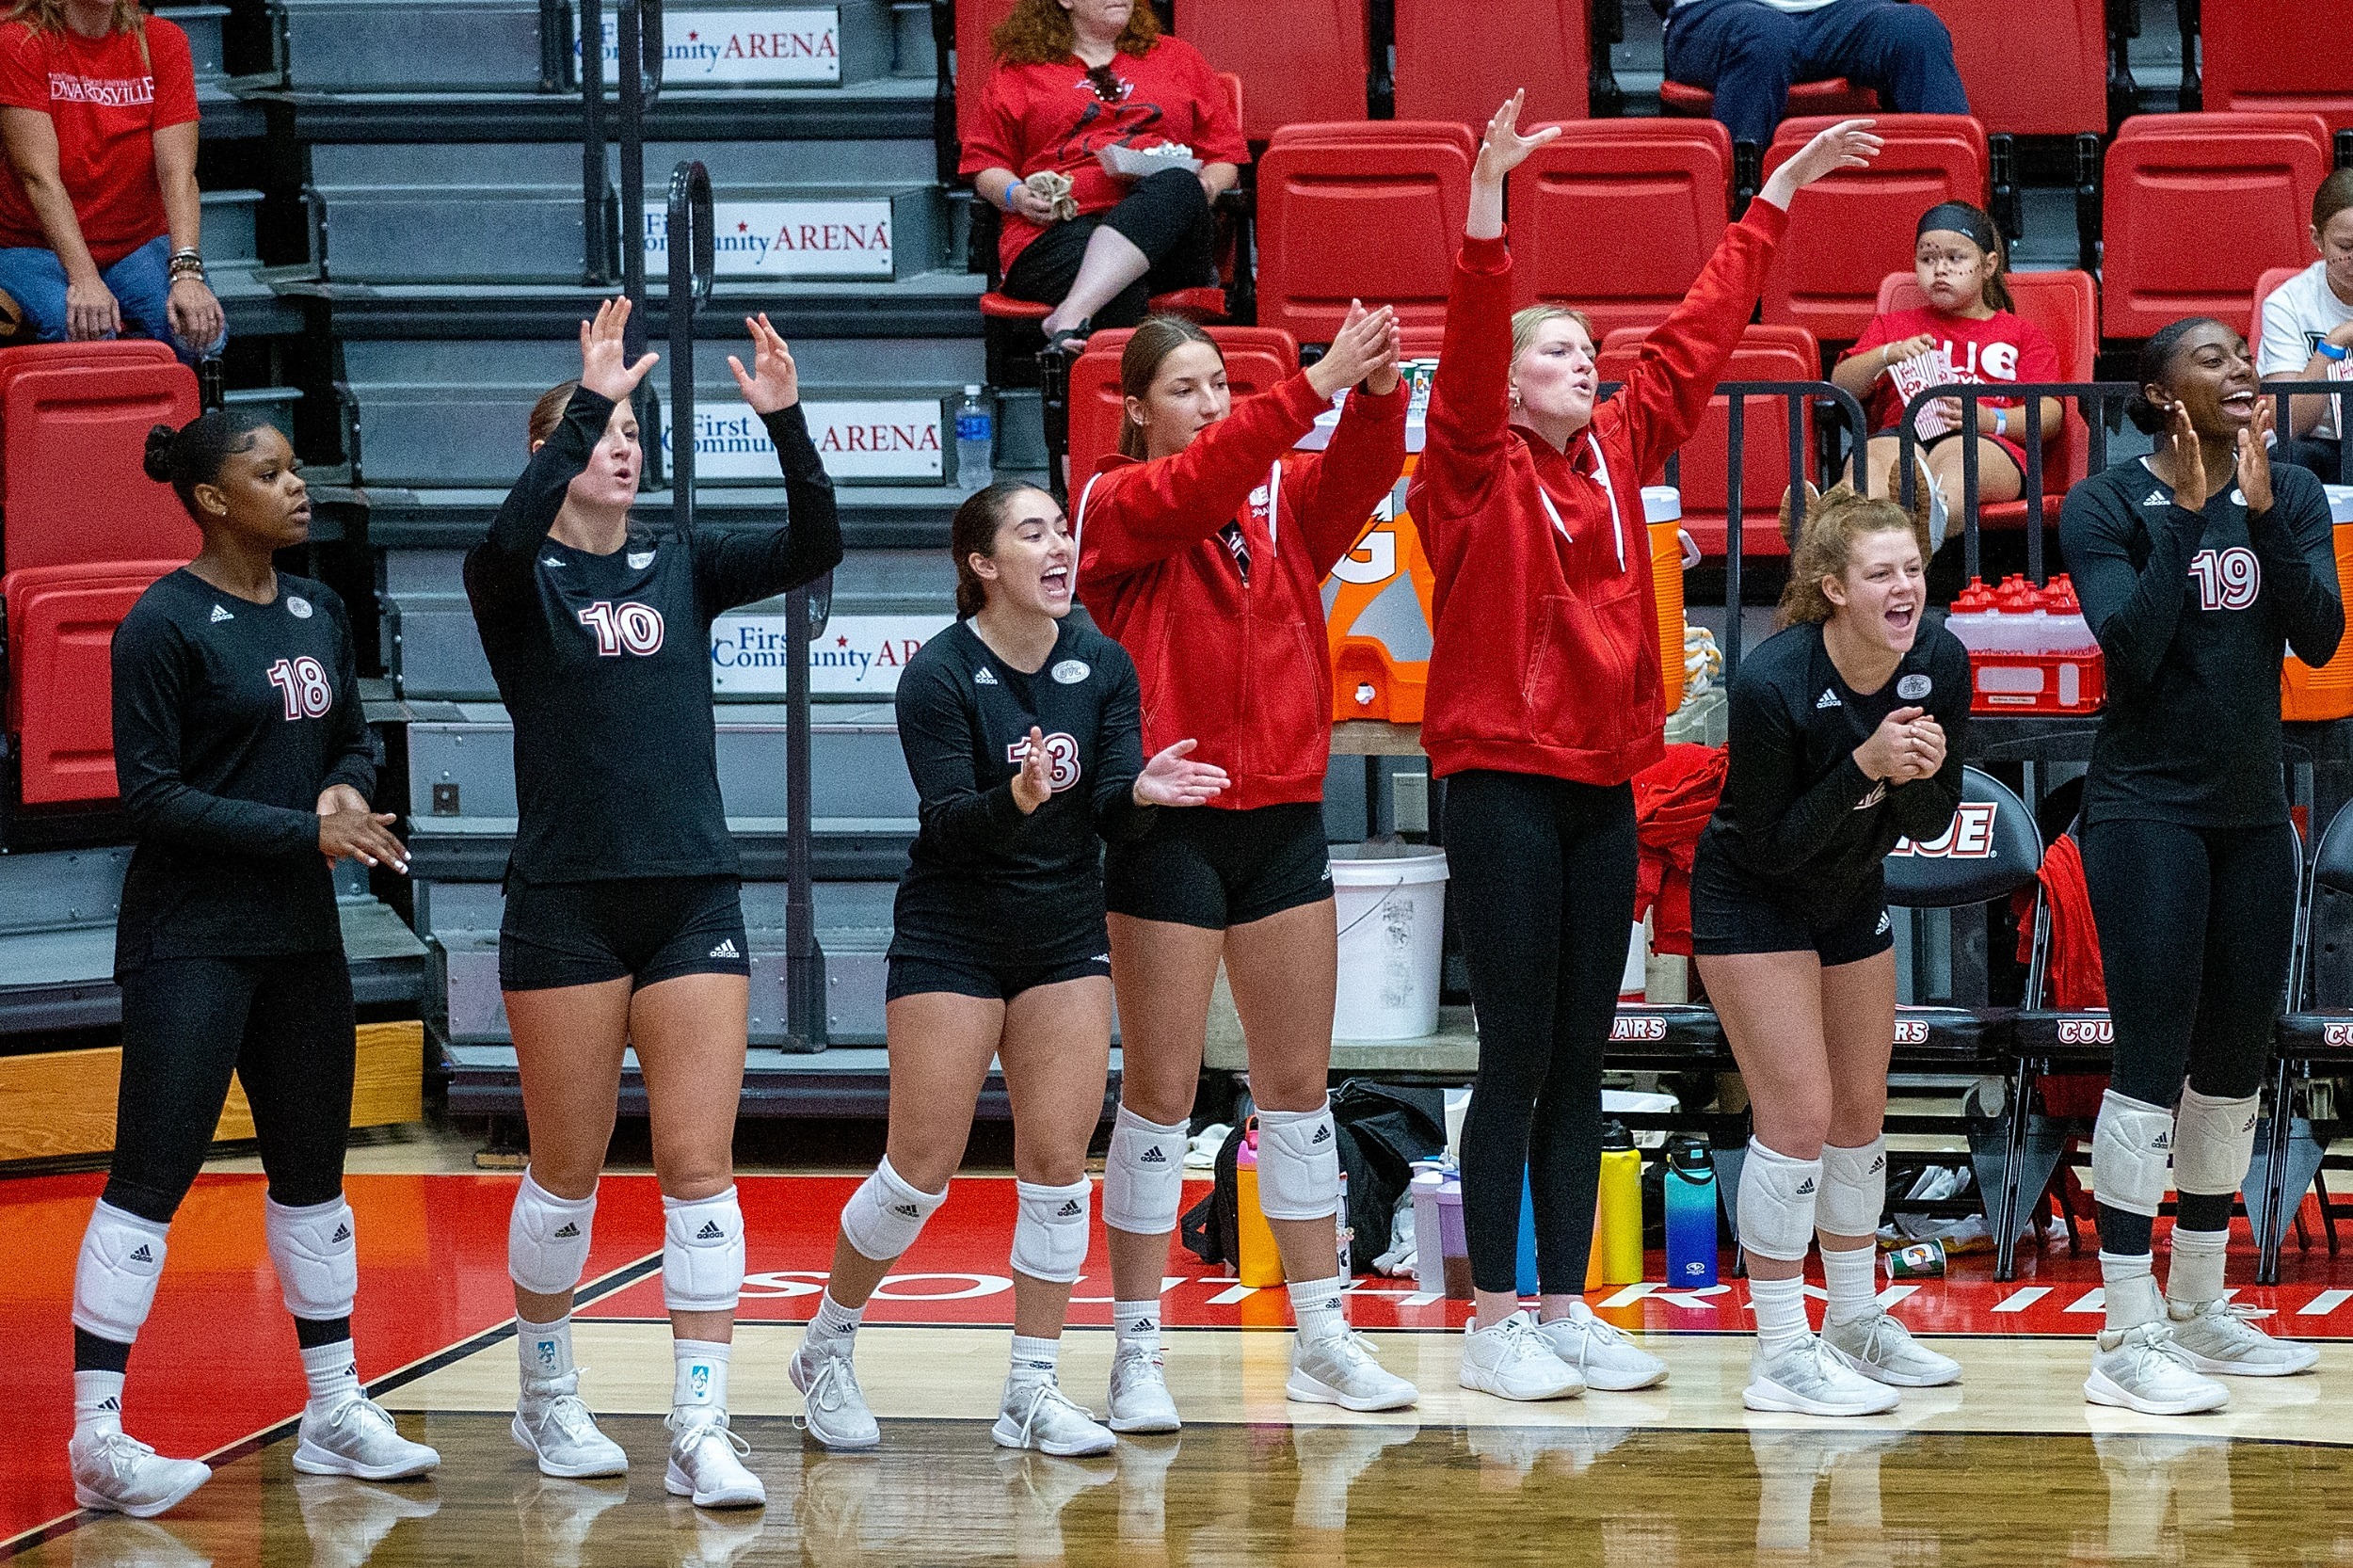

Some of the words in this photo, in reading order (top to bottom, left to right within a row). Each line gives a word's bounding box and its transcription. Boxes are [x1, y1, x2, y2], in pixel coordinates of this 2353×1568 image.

[724, 33, 837, 59] ARENA
[774, 224, 891, 251] ARENA
[821, 424, 940, 452] ARENA
[2187, 547, 2261, 611] 19
[578, 601, 664, 656] 10
[267, 656, 332, 721] 18
[555, 1230, 581, 1239] adidas
[697, 1230, 725, 1240] adidas
